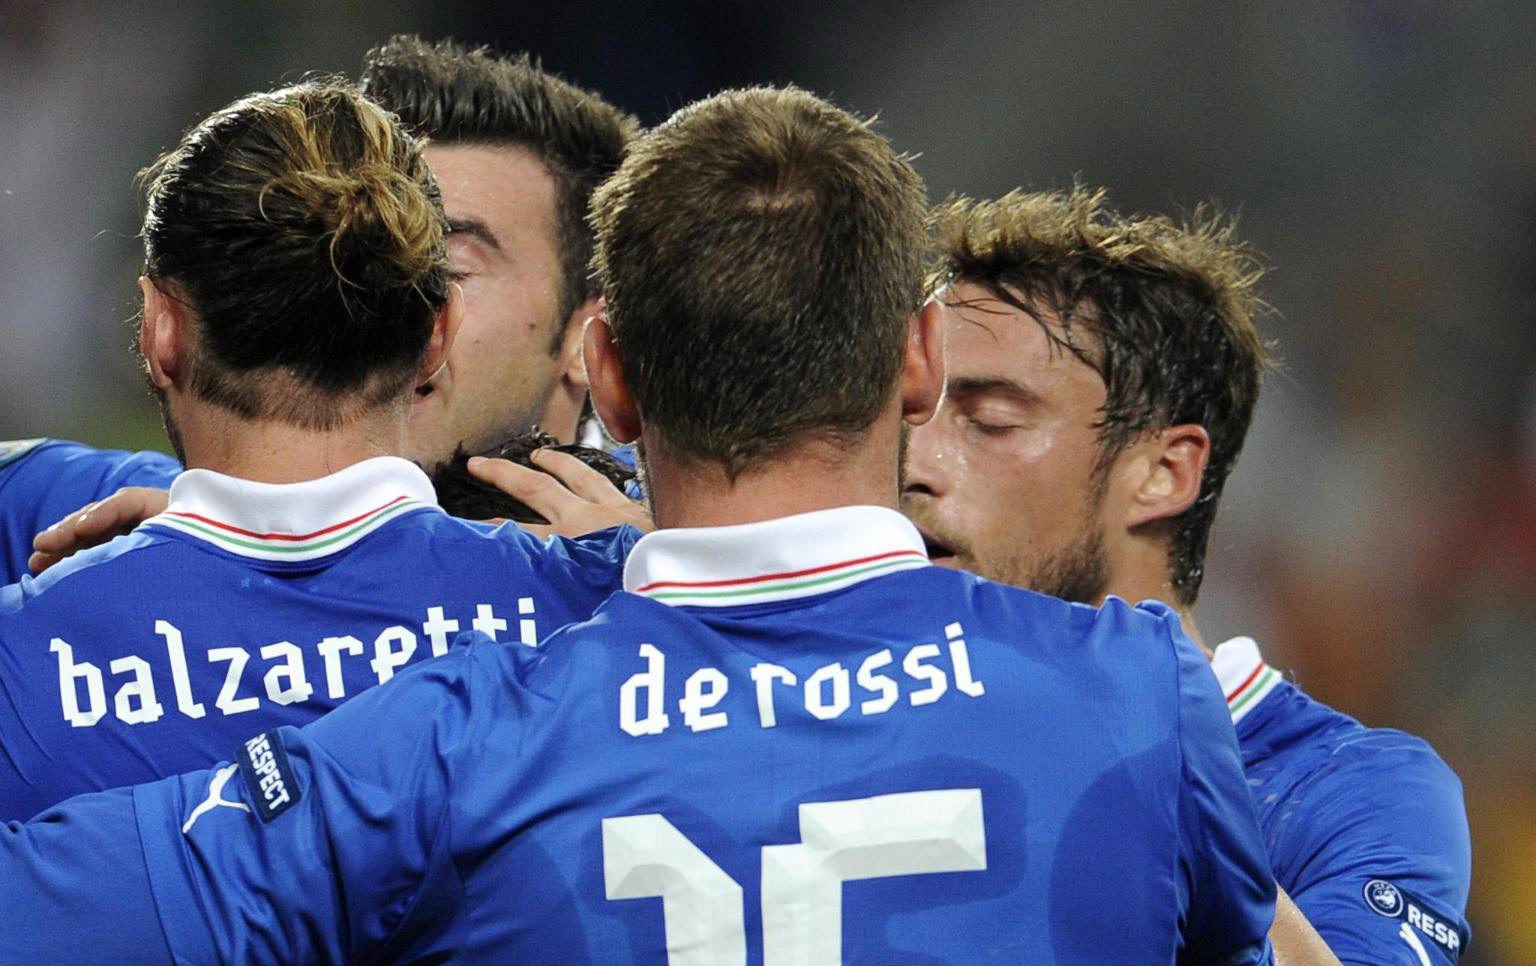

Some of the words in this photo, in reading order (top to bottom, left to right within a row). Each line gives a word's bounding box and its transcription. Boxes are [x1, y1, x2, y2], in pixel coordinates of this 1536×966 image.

[50, 597, 537, 727] balzaretti
[750, 622, 985, 728] rossi
[1407, 903, 1460, 950] RESP
